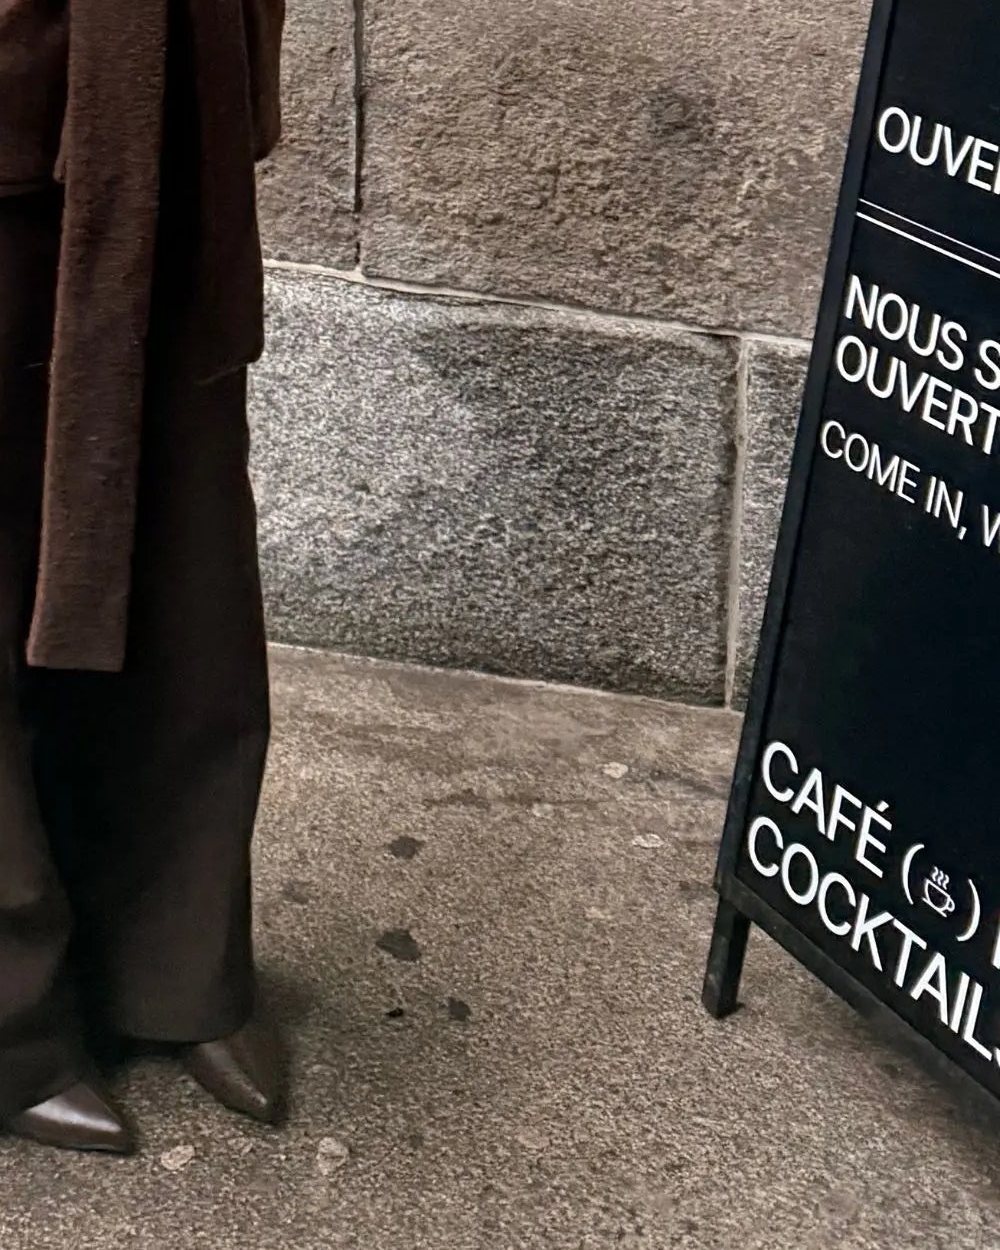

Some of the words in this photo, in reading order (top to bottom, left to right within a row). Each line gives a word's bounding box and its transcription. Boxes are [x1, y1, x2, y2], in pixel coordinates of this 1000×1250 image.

[844, 274, 967, 371] NOUS
[835, 335, 1000, 455] OUVERT
[820, 420, 921, 504] COME
[924, 476, 967, 540] IN,
[762, 741, 892, 878] CAFÉ
[748, 816, 1000, 1067] COCKTAIL
